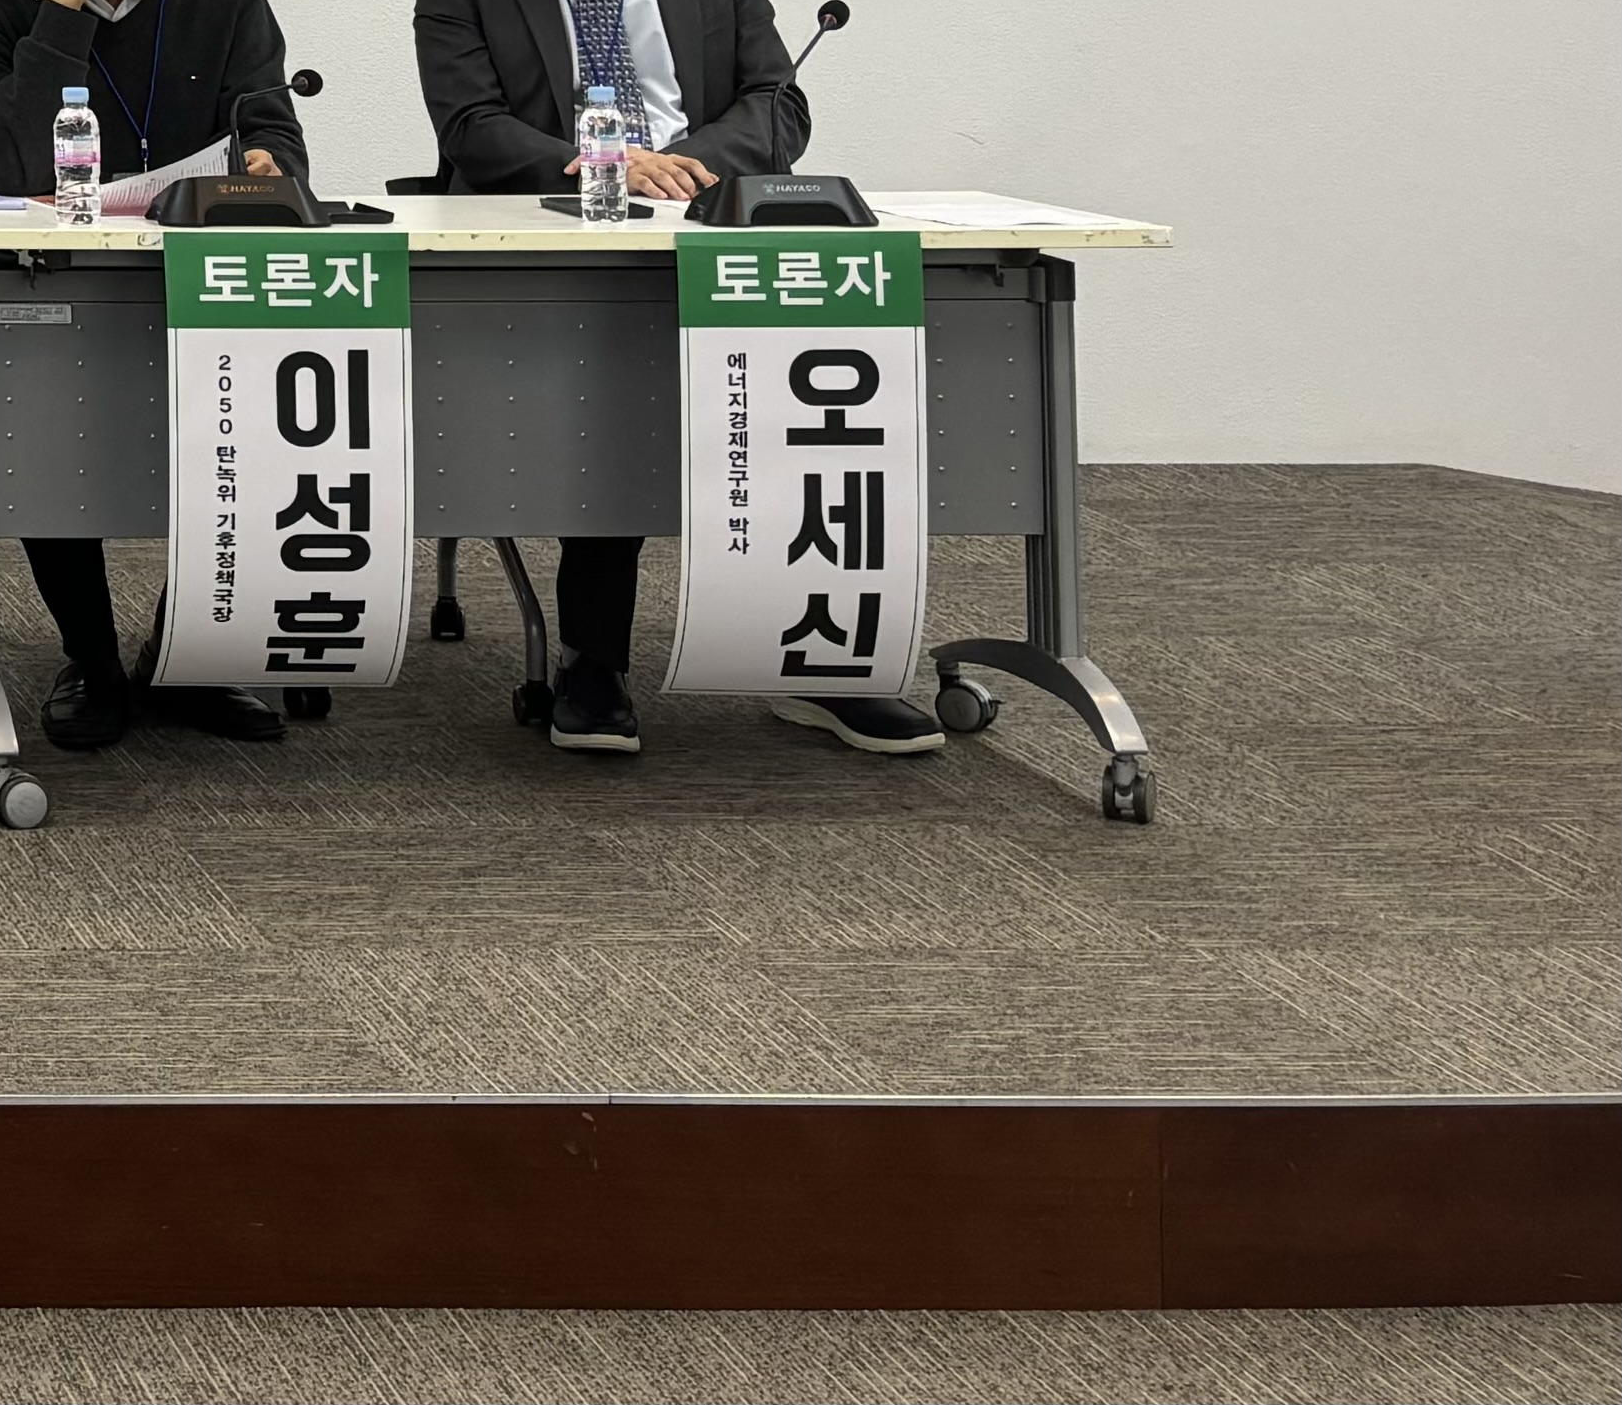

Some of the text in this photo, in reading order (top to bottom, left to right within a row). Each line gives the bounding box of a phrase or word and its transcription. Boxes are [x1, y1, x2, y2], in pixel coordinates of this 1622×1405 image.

[199, 252, 380, 308] 토론자
[710, 250, 892, 307] 토론자
[212, 354, 237, 623] 2050 탄녹위 기후정책국장
[264, 348, 371, 674] 이성훈
[727, 352, 750, 555] 에너지경제연구원 박사
[779, 349, 885, 679] 오세신
